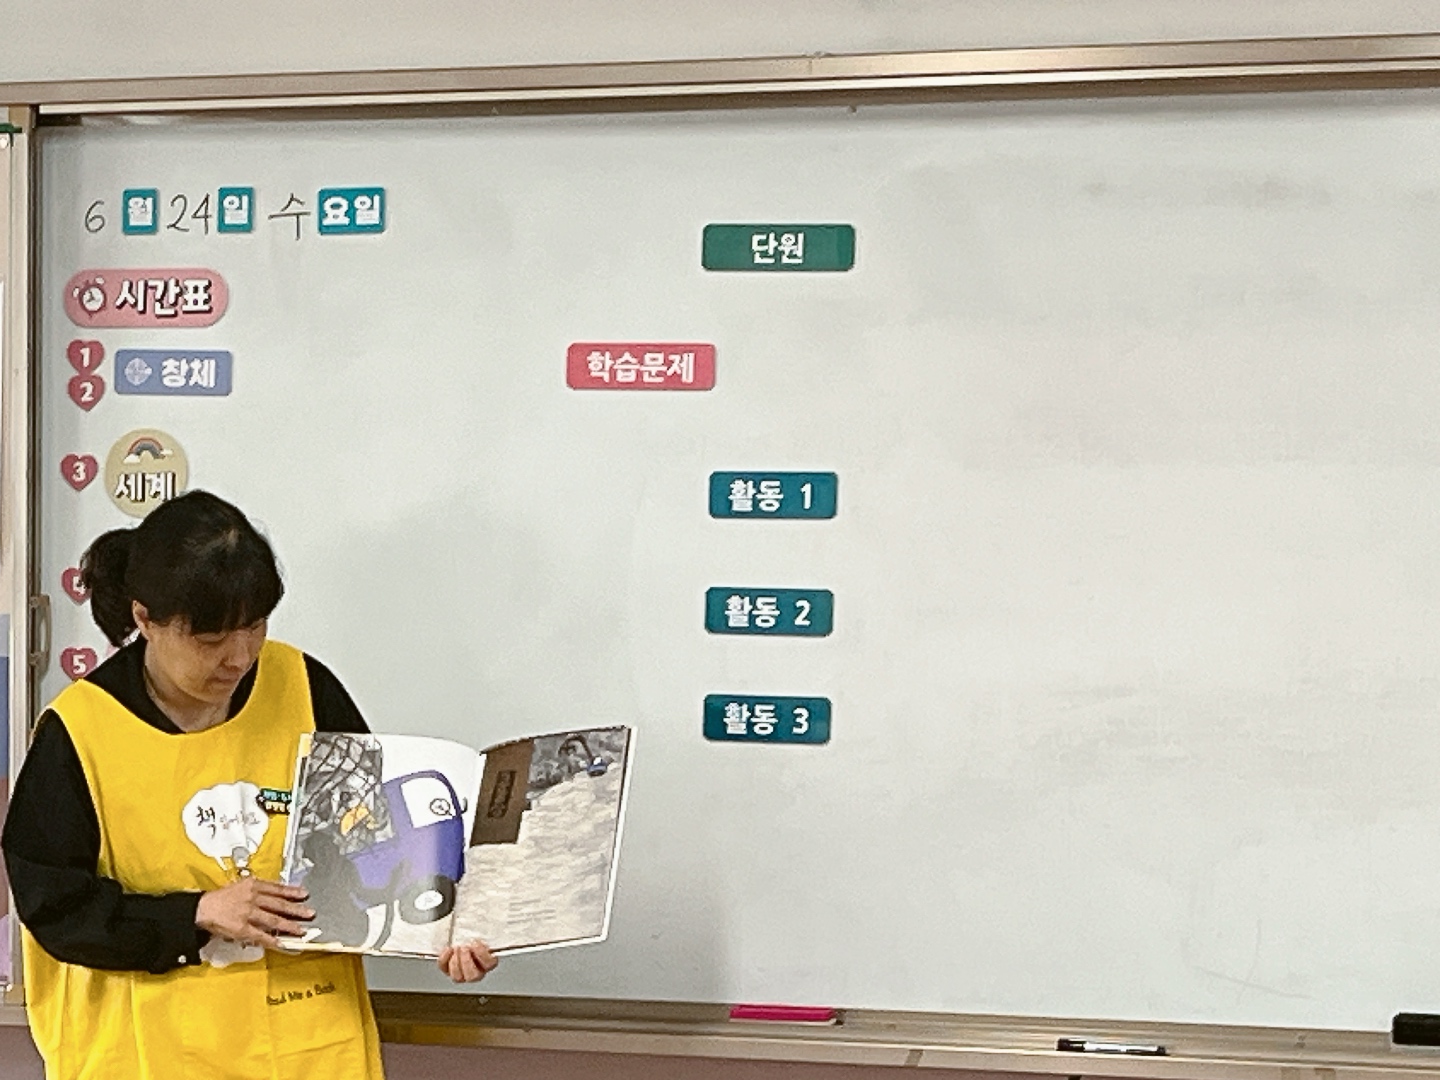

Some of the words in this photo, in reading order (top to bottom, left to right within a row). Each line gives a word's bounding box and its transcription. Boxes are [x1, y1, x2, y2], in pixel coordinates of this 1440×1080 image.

[83, 199, 106, 233] 6
[166, 193, 213, 235] 24
[268, 192, 312, 241] 수
[321, 193, 381, 227] 요일
[750, 231, 805, 265] 단원
[115, 277, 214, 319] 시간표
[79, 346, 91, 369] 1
[161, 357, 217, 389] 창체
[585, 350, 697, 384] 학습문제
[80, 382, 96, 404] 2
[71, 460, 87, 483] 3
[115, 470, 177, 502] 세계
[727, 480, 784, 513] 활동
[799, 483, 812, 510] 1
[724, 594, 781, 627] 활동
[794, 599, 812, 626] 2
[72, 654, 87, 675] 5
[722, 703, 779, 736] 활동
[791, 707, 810, 735] 3
